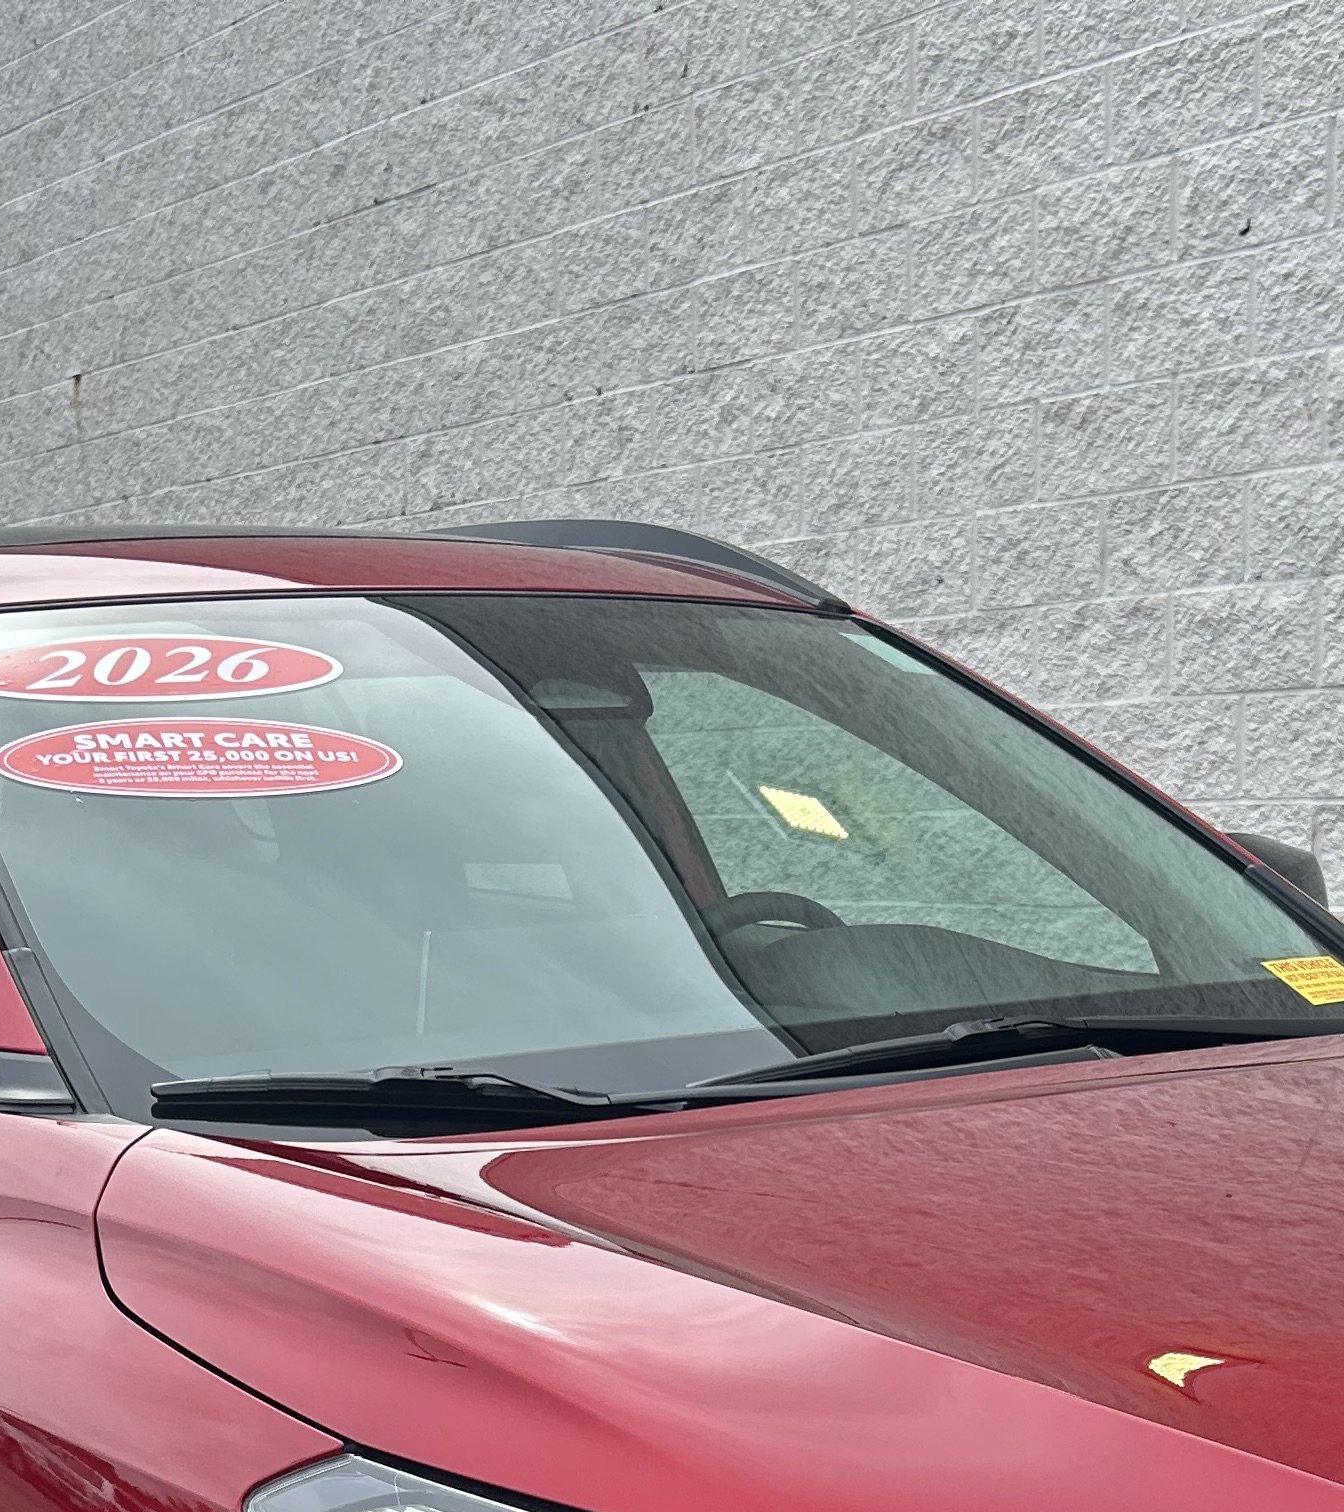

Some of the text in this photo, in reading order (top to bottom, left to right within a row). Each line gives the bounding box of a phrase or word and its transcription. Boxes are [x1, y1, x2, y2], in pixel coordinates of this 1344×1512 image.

[26, 646, 278, 690] 2026
[73, 732, 313, 750] SMART CARE
[35, 750, 359, 766] YOUR FIRST 25,000 ON US!
